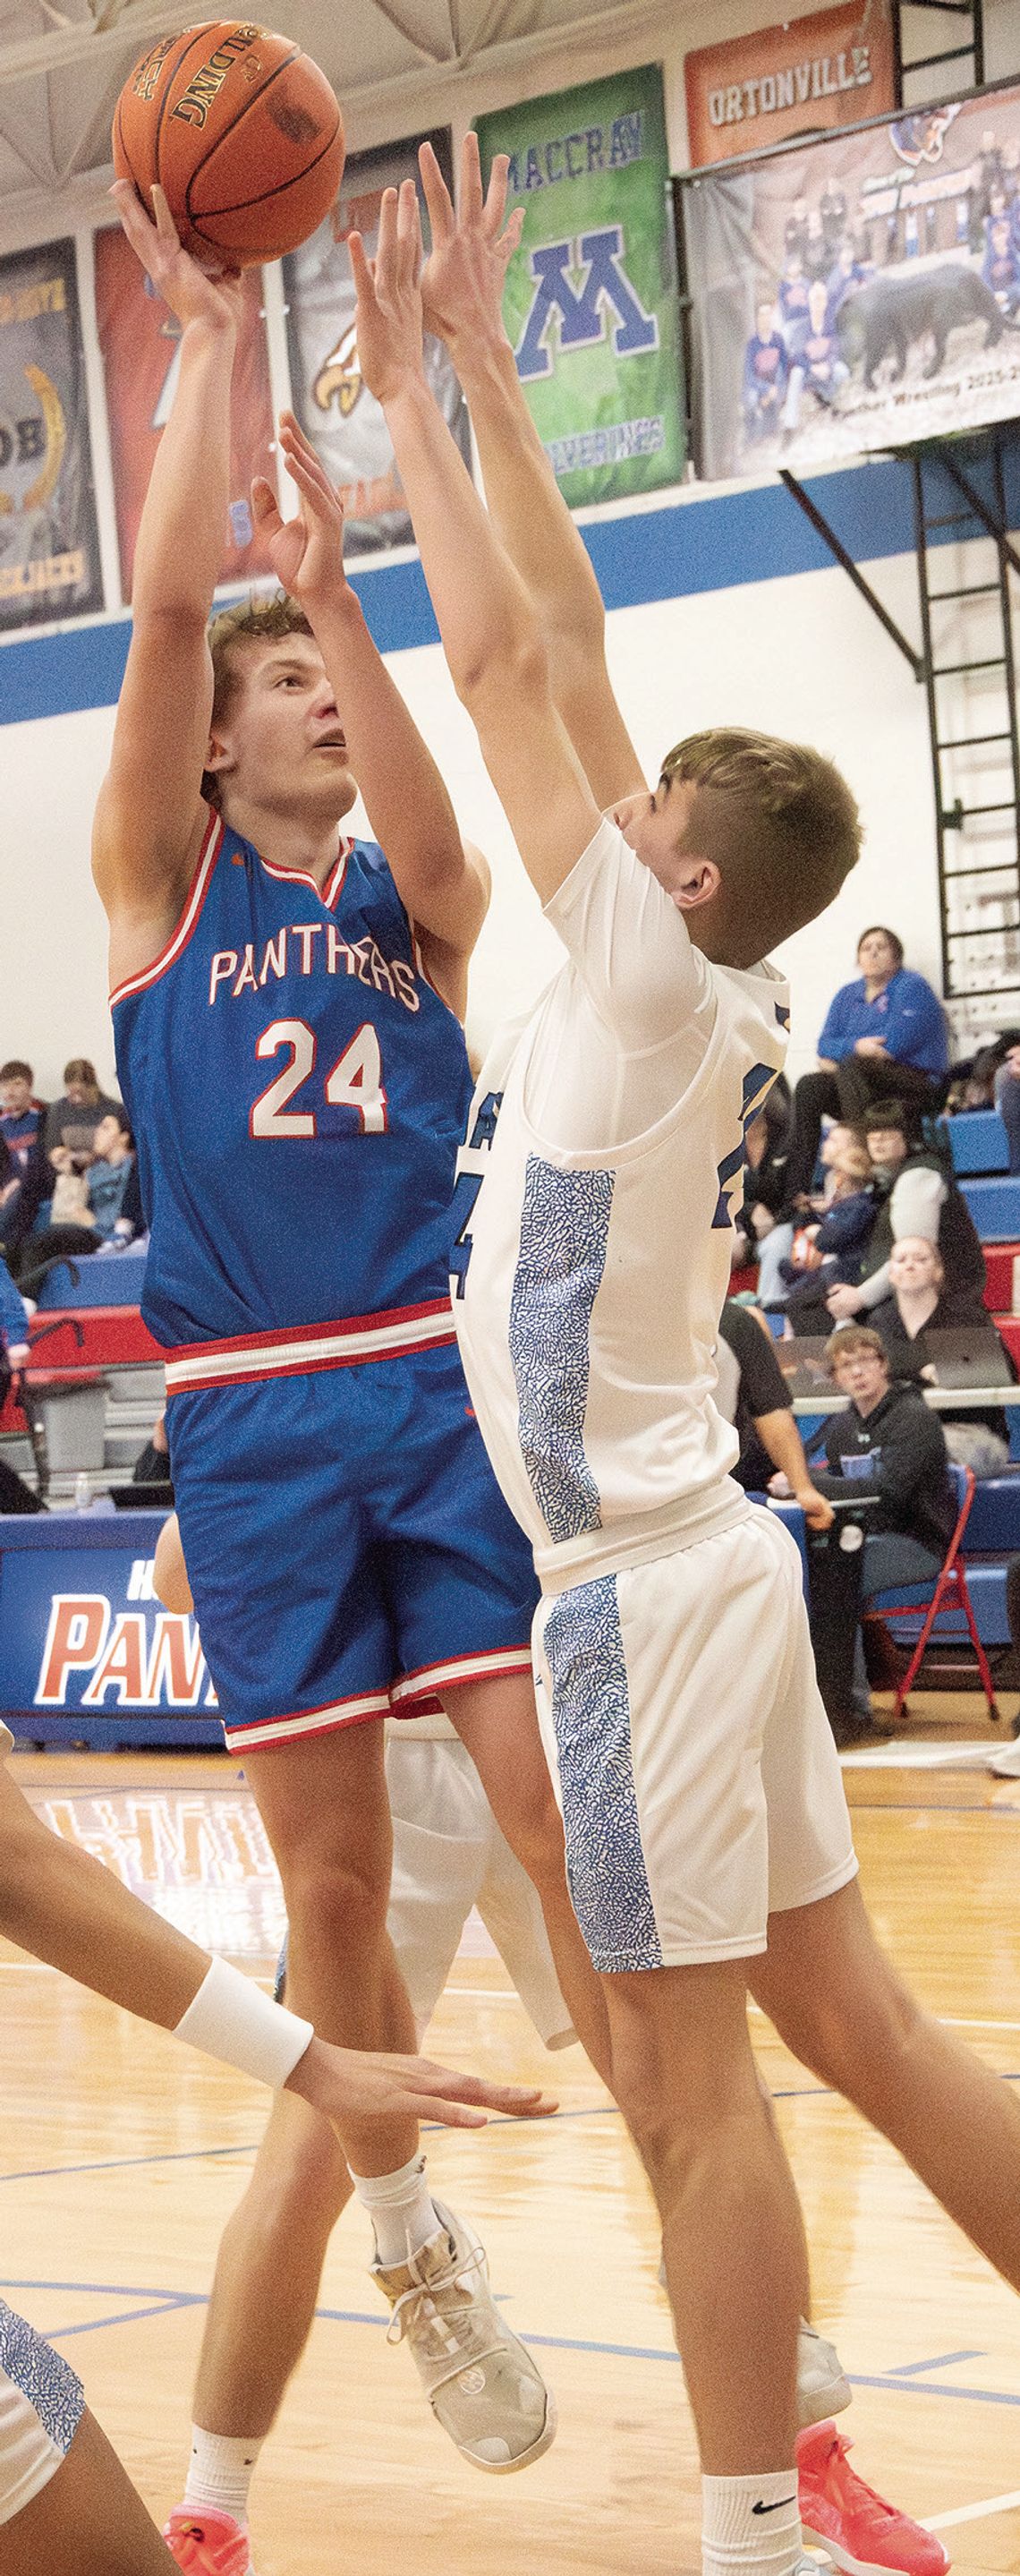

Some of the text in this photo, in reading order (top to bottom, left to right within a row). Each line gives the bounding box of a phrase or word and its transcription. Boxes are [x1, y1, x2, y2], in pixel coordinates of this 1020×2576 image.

[709, 47, 873, 126] ORTONVILLE
[514, 225, 659, 383] M
[208, 923, 420, 1012] PANTHERS
[249, 1017, 388, 1139] 24
[34, 1594, 219, 1706] PAN
